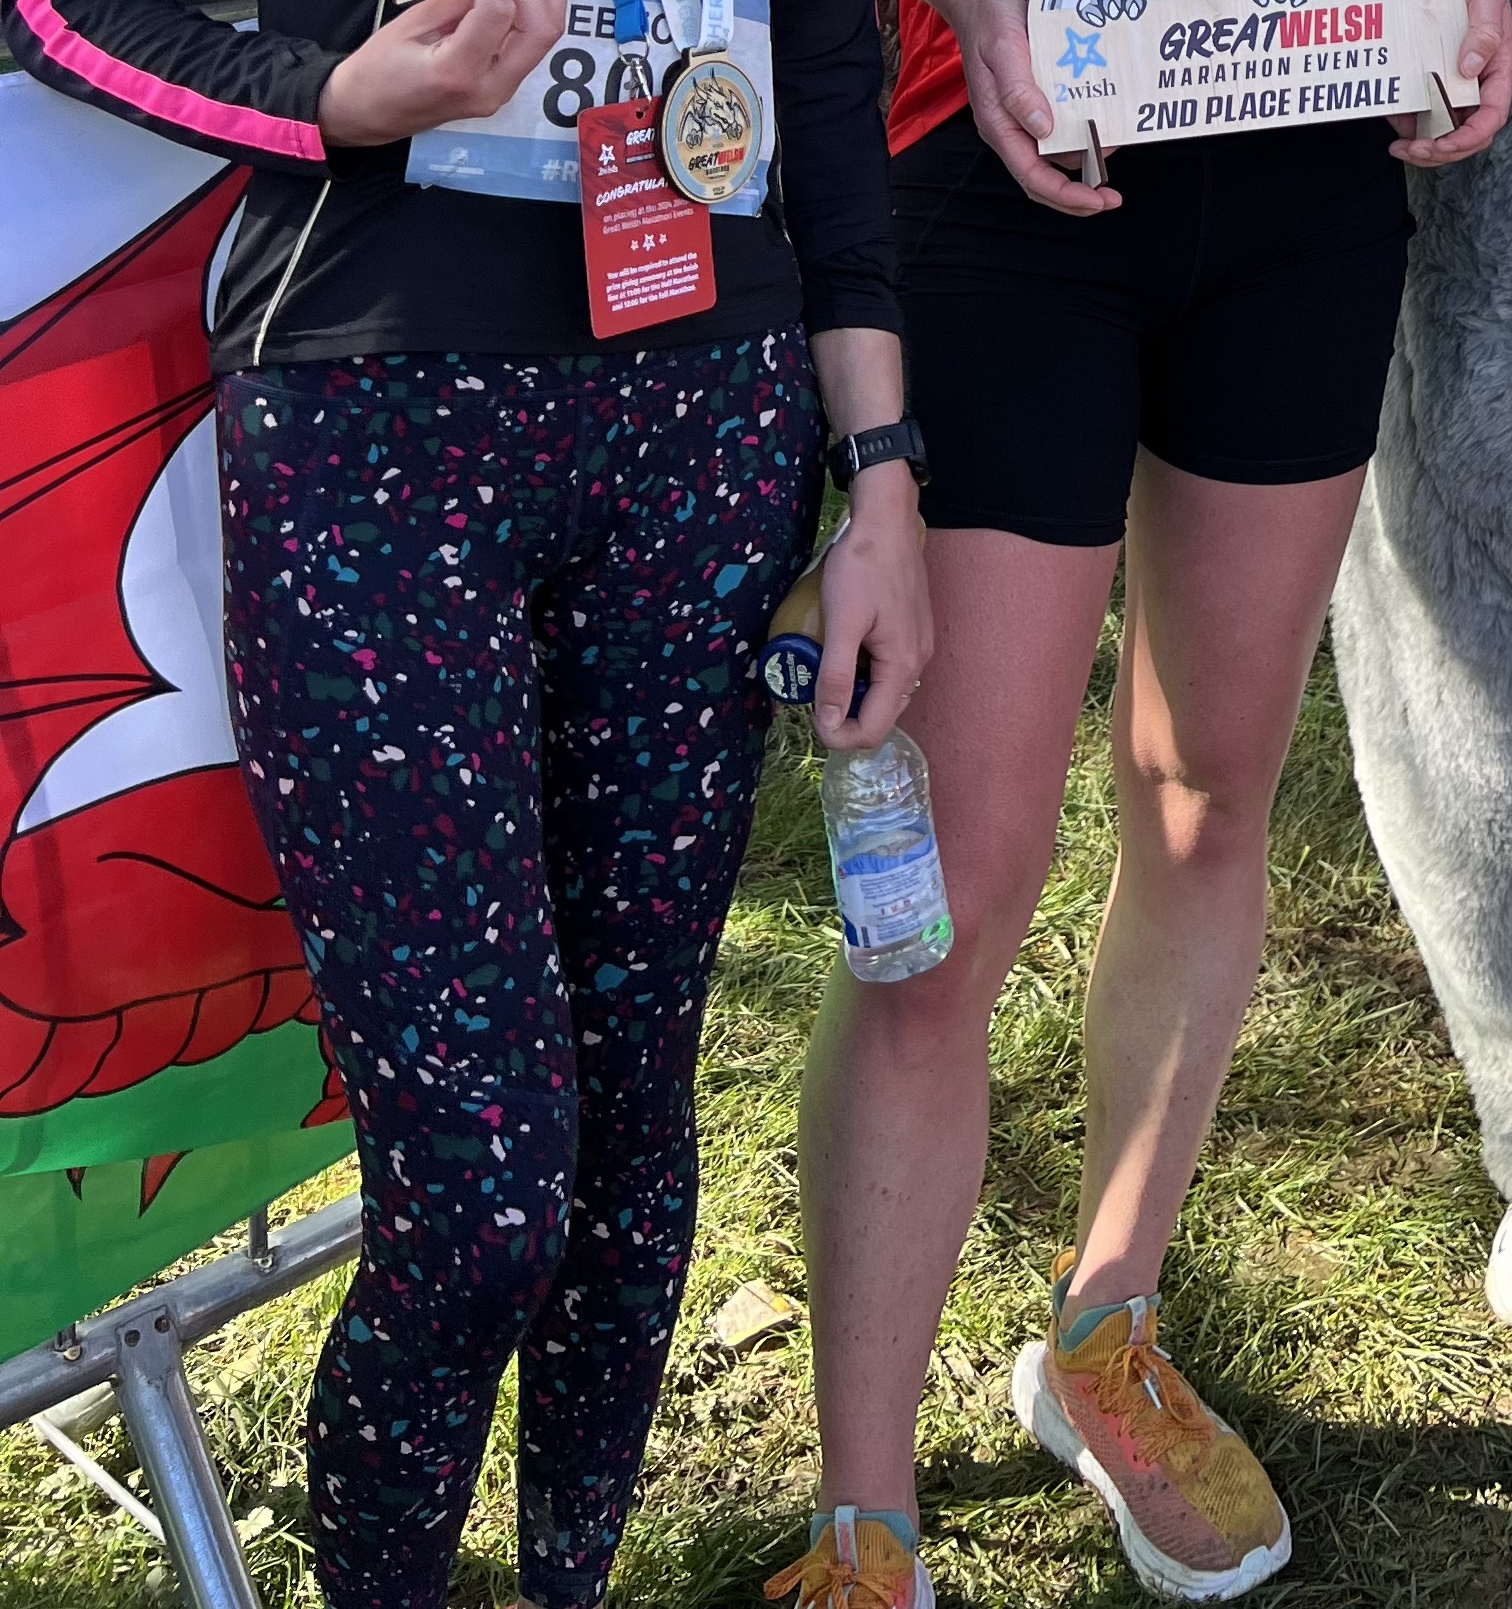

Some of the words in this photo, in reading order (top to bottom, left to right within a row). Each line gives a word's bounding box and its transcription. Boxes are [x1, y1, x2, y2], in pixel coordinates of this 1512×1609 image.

[1158, 59, 1291, 90] MARATHON
[1303, 46, 1389, 74] EVENTS
[1055, 78, 1117, 104] 2wish
[1136, 100, 1198, 133] 2ND
[1205, 89, 1291, 125] PLACE
[1298, 76, 1401, 114] FEMALE
[596, 177, 668, 206] CONGRATULA
